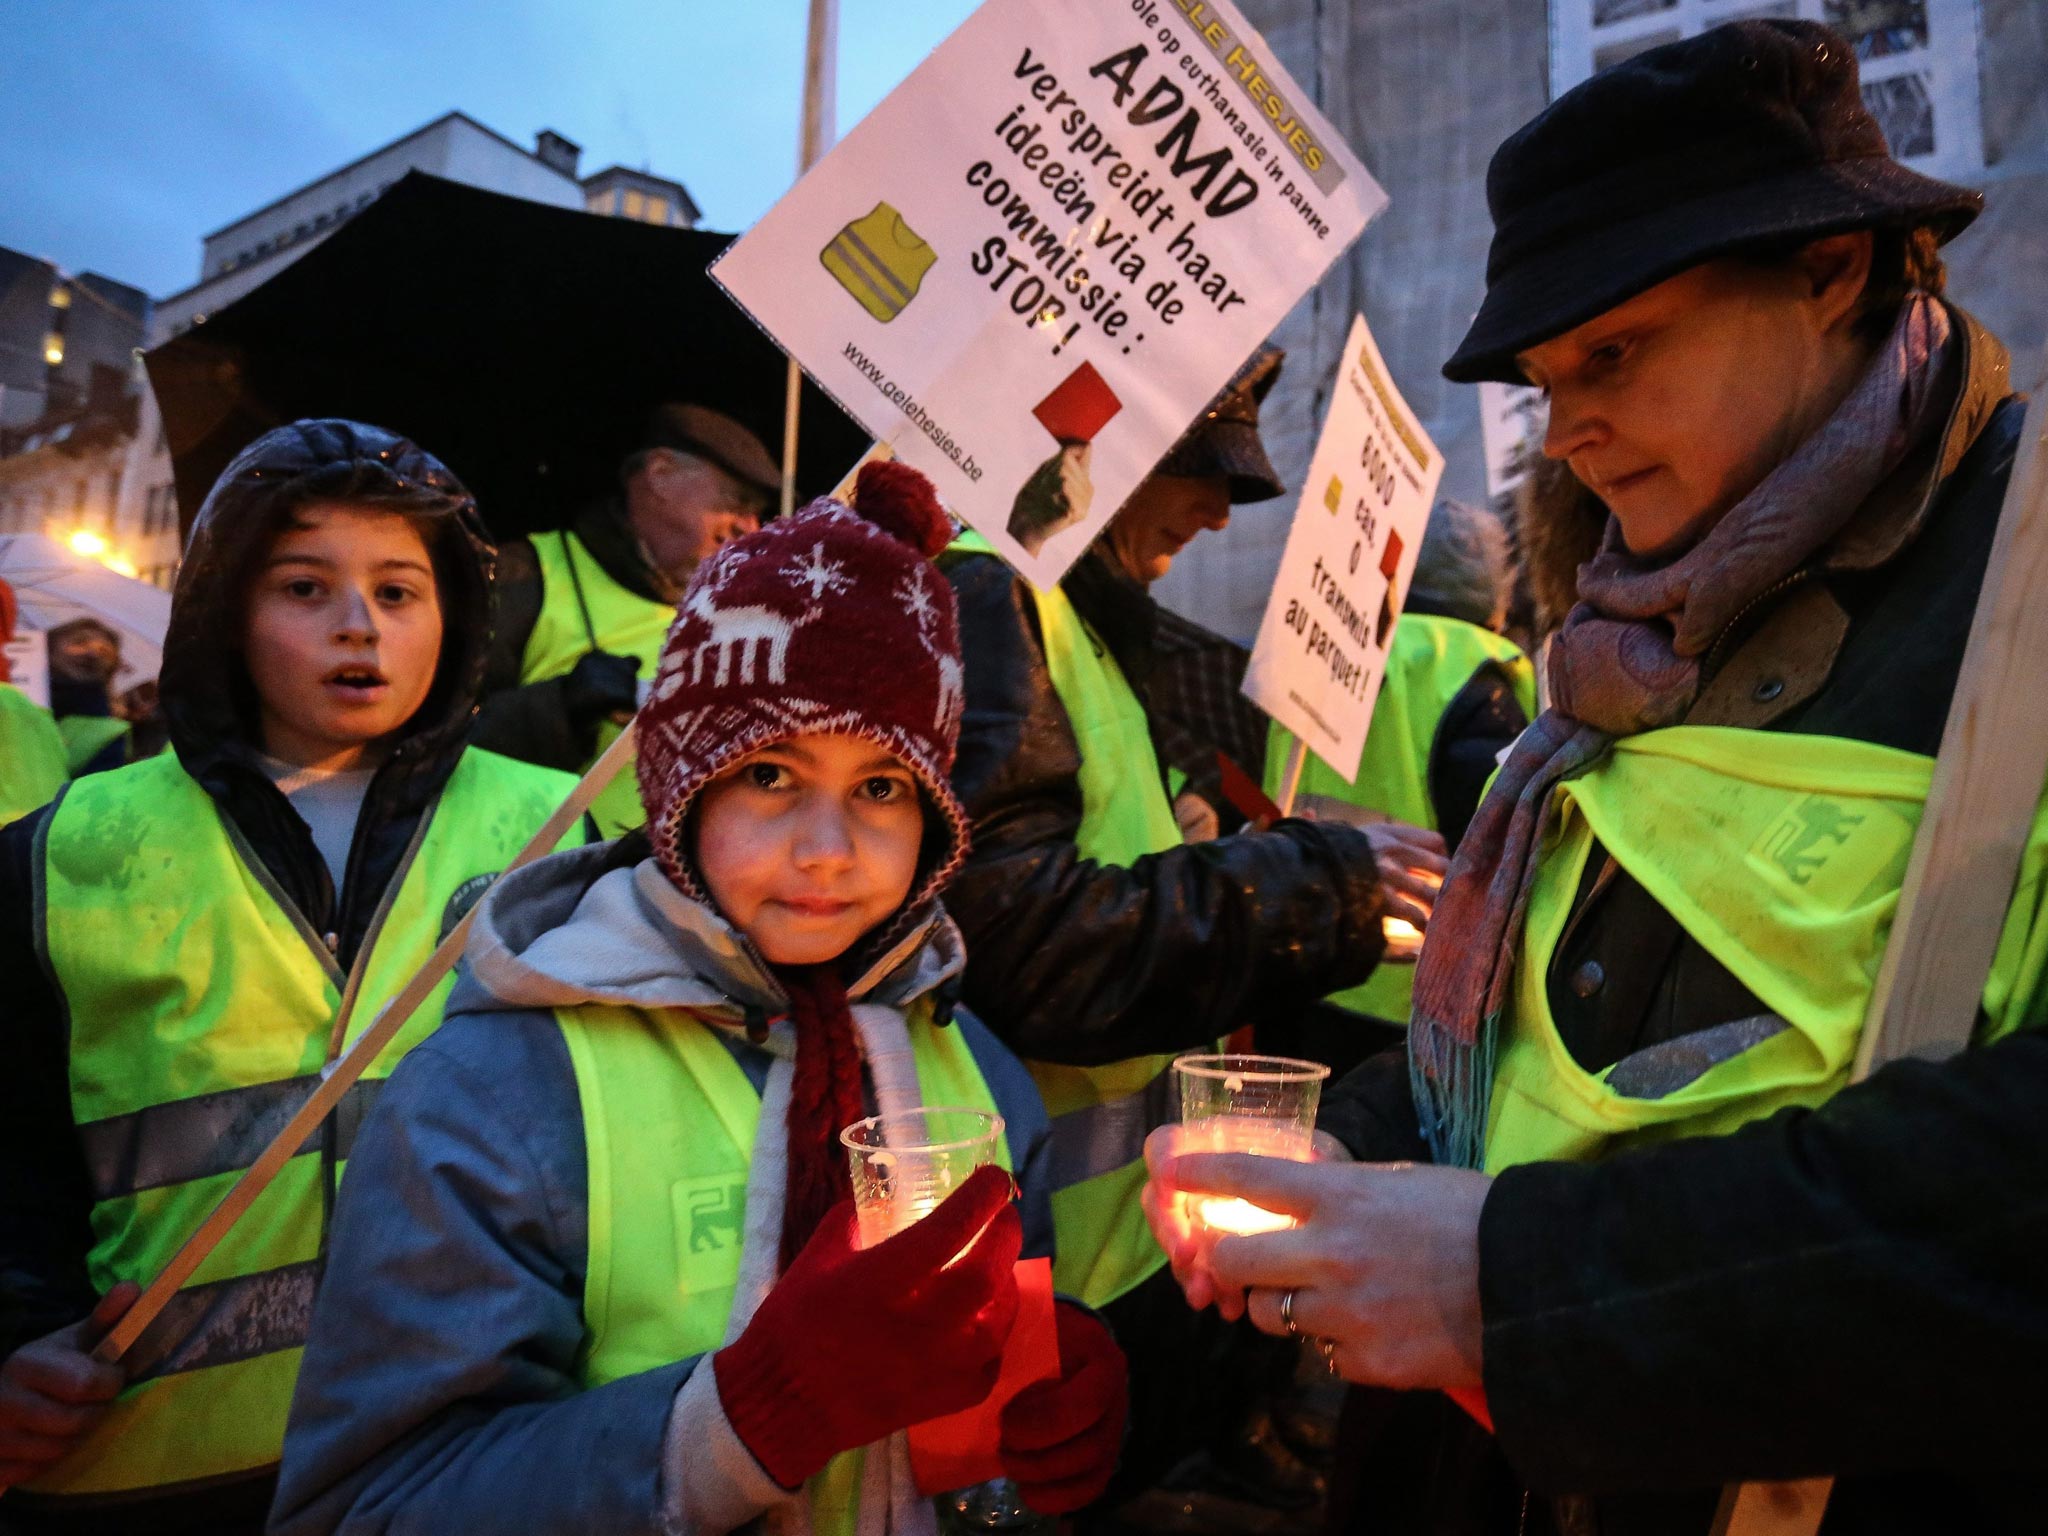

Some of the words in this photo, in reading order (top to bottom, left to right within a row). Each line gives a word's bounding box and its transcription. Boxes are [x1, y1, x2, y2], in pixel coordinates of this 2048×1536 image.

[1089, 43, 1259, 218] ADMD
[1157, 28, 1180, 54] op
[1179, 55, 1267, 162] euthanasie
[1264, 155, 1284, 183] in
[1279, 181, 1330, 240] panne
[1177, 0, 1229, 50] LE
[1226, 45, 1325, 172] HESJES
[995, 104, 1096, 225] ideeën
[1095, 218, 1146, 284] via
[1145, 280, 1184, 325] de
[1014, 47, 1175, 233] verspreidt
[1166, 221, 1246, 313] haar
[843, 341, 983, 484] www.gelehesjes.be
[1284, 598, 1309, 636] au
[1311, 555, 1370, 649] transmis
